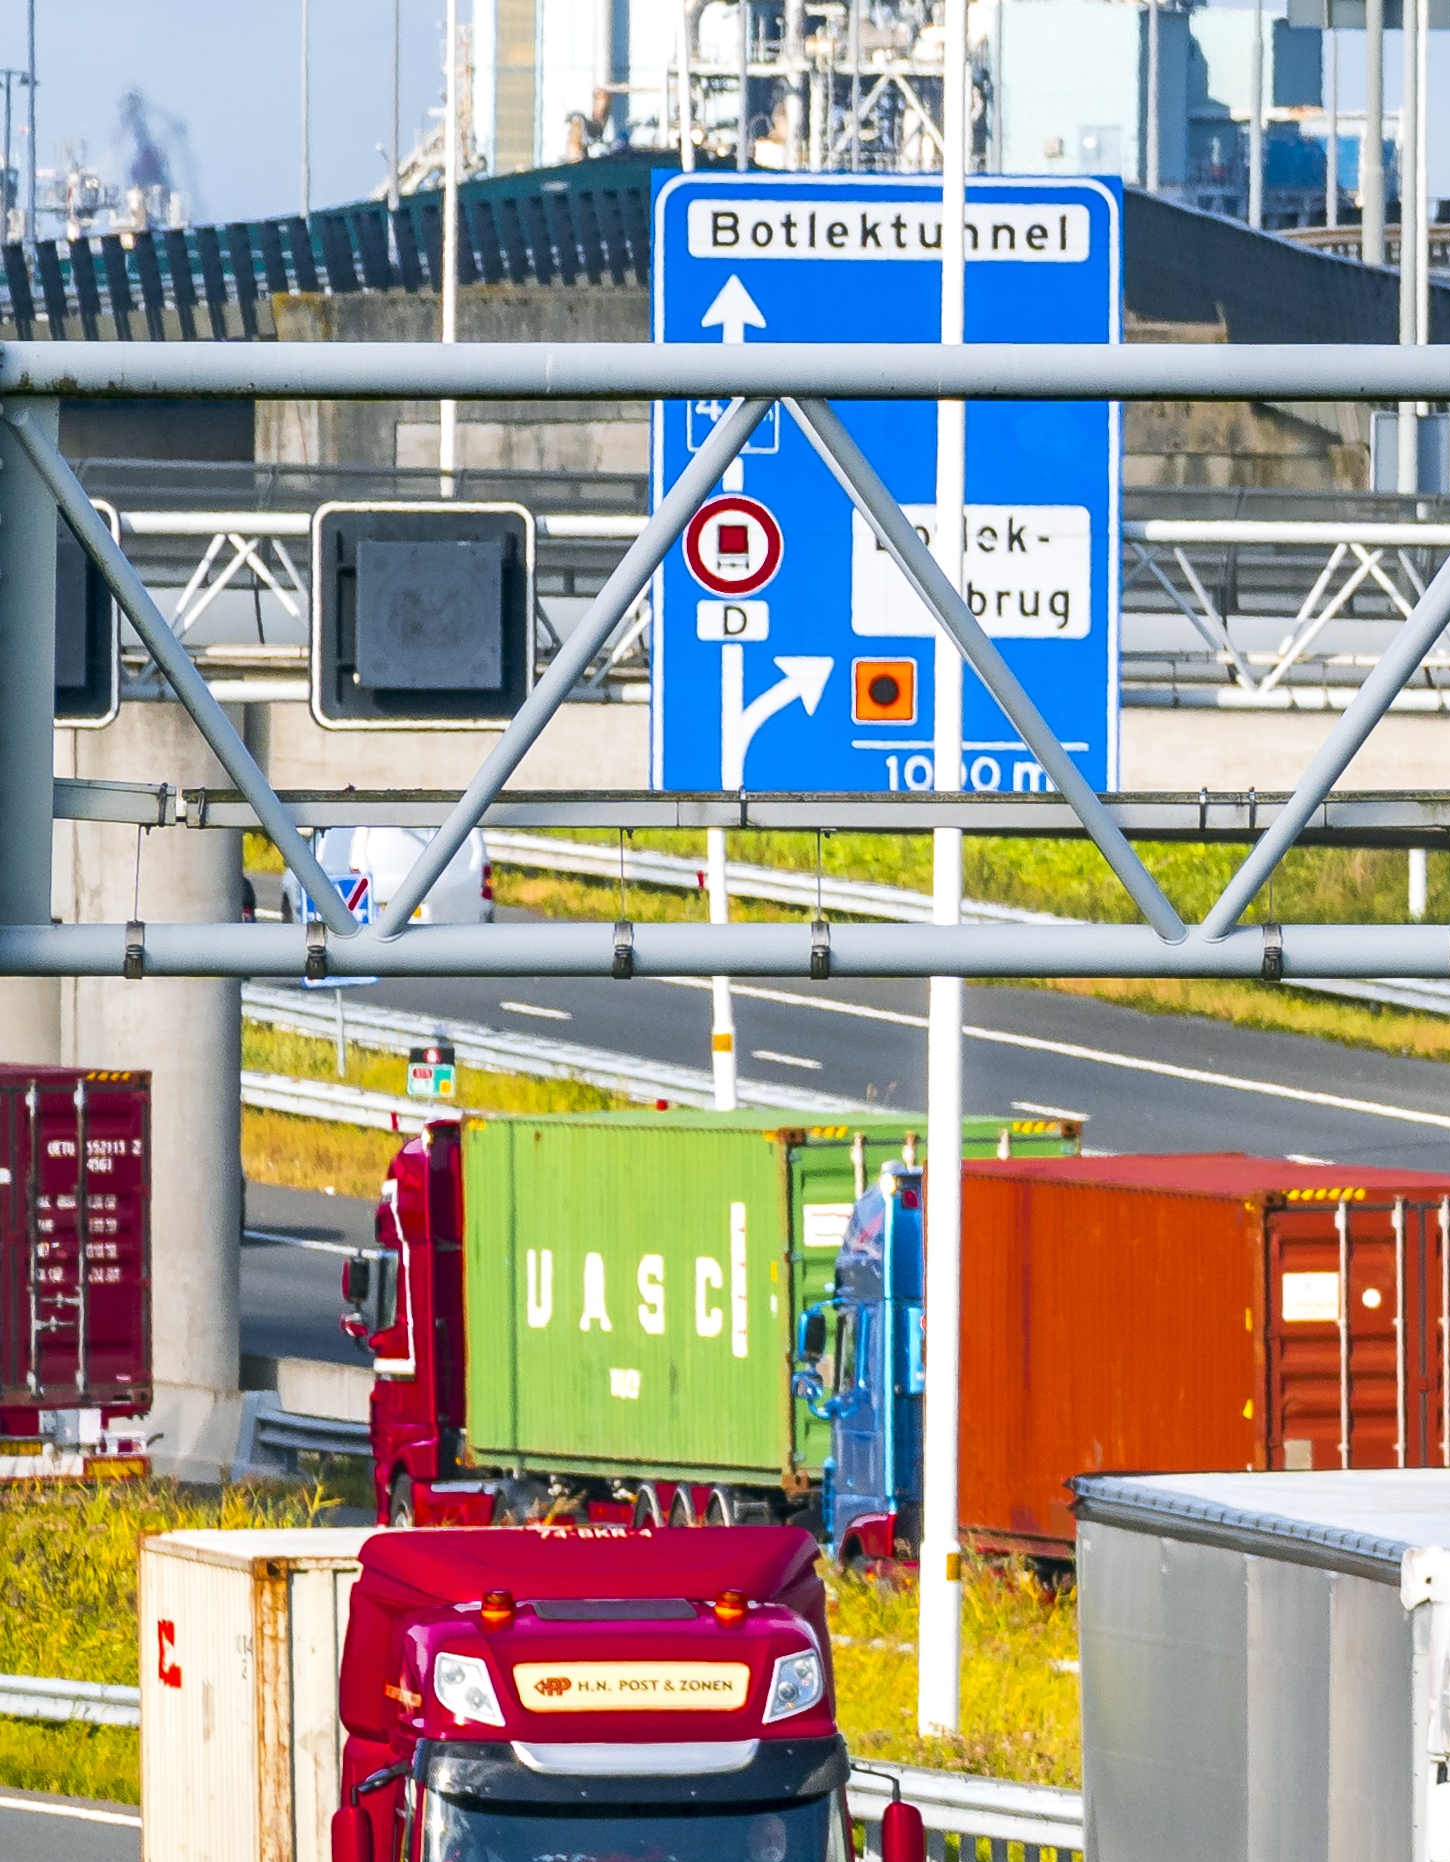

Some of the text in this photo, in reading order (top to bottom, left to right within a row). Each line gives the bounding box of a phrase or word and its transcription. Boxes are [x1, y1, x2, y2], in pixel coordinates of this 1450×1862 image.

[711, 211, 1069, 252] Botlektunnel
[723, 606, 748, 636] D
[885, 754, 1001, 792] 100
[619, 1680, 660, 1692] POST
[664, 1679, 676, 1692] &
[679, 1680, 733, 1692] ZONEN
